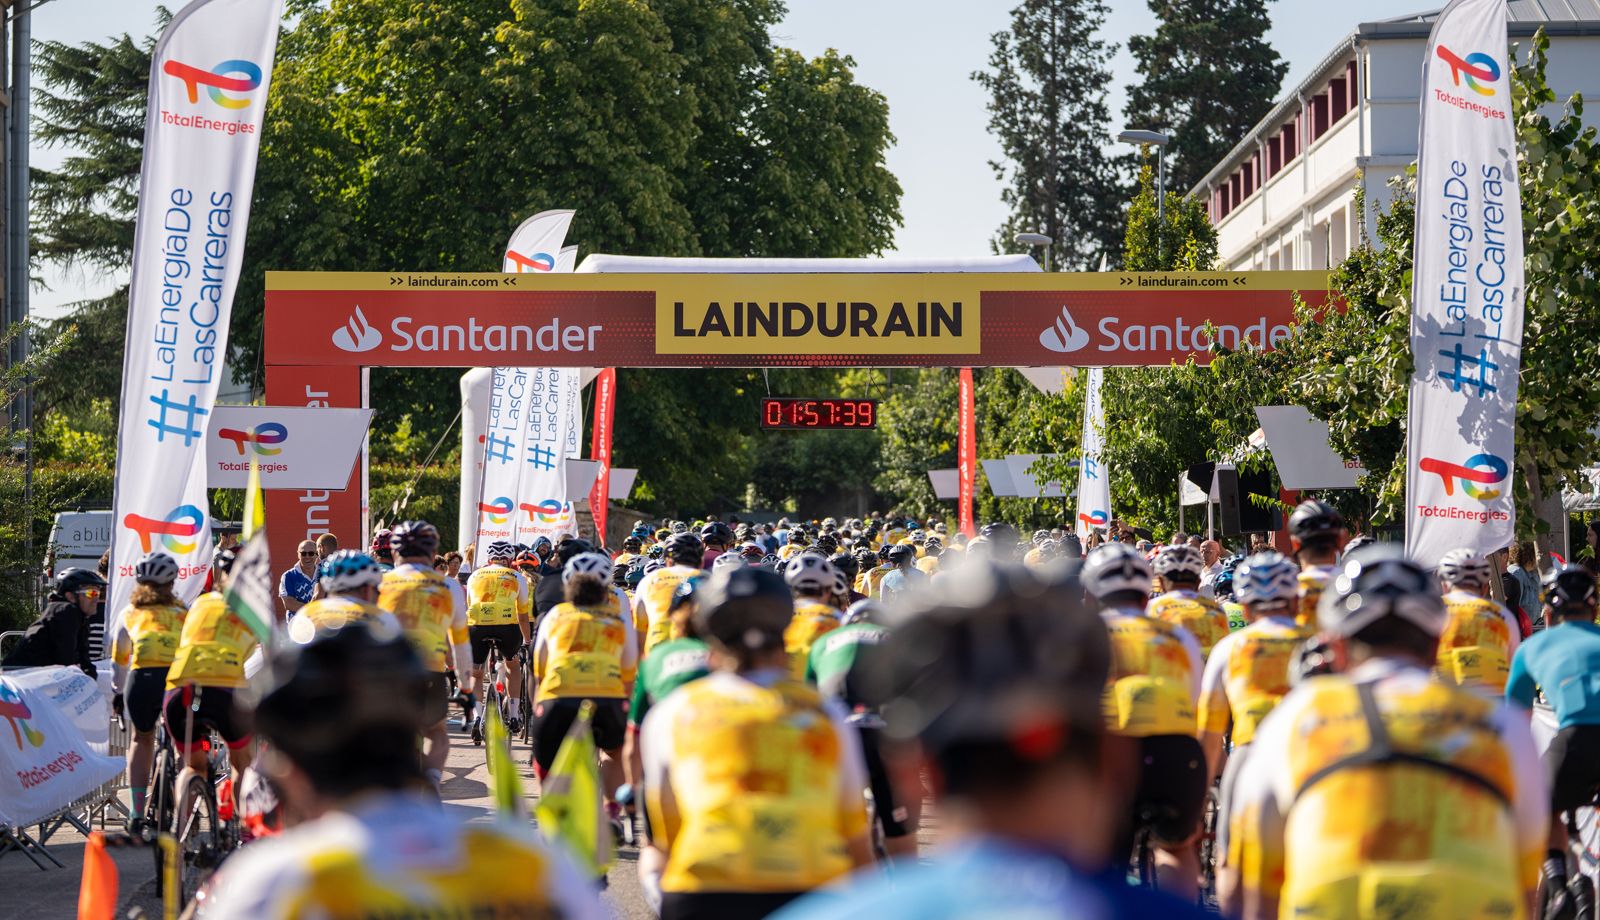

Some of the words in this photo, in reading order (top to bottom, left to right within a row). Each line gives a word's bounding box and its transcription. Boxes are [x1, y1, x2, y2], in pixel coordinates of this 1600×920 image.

[1435, 88, 1505, 120] TotalEnergies
[161, 110, 255, 136] TotalEnergies
[1474, 165, 1505, 341] LasCarreras
[182, 191, 233, 385] LasCarreras
[408, 275, 499, 287] laindurain.com
[1138, 275, 1228, 287] laindurain.com
[390, 316, 603, 352] Santander
[674, 302, 963, 338] LAINDURAIN
[1098, 316, 1300, 352] Santande
[767, 401, 872, 426] 01:57:39
[218, 462, 288, 473] TotalEergies
[1417, 504, 1509, 524] TotalEnergies
